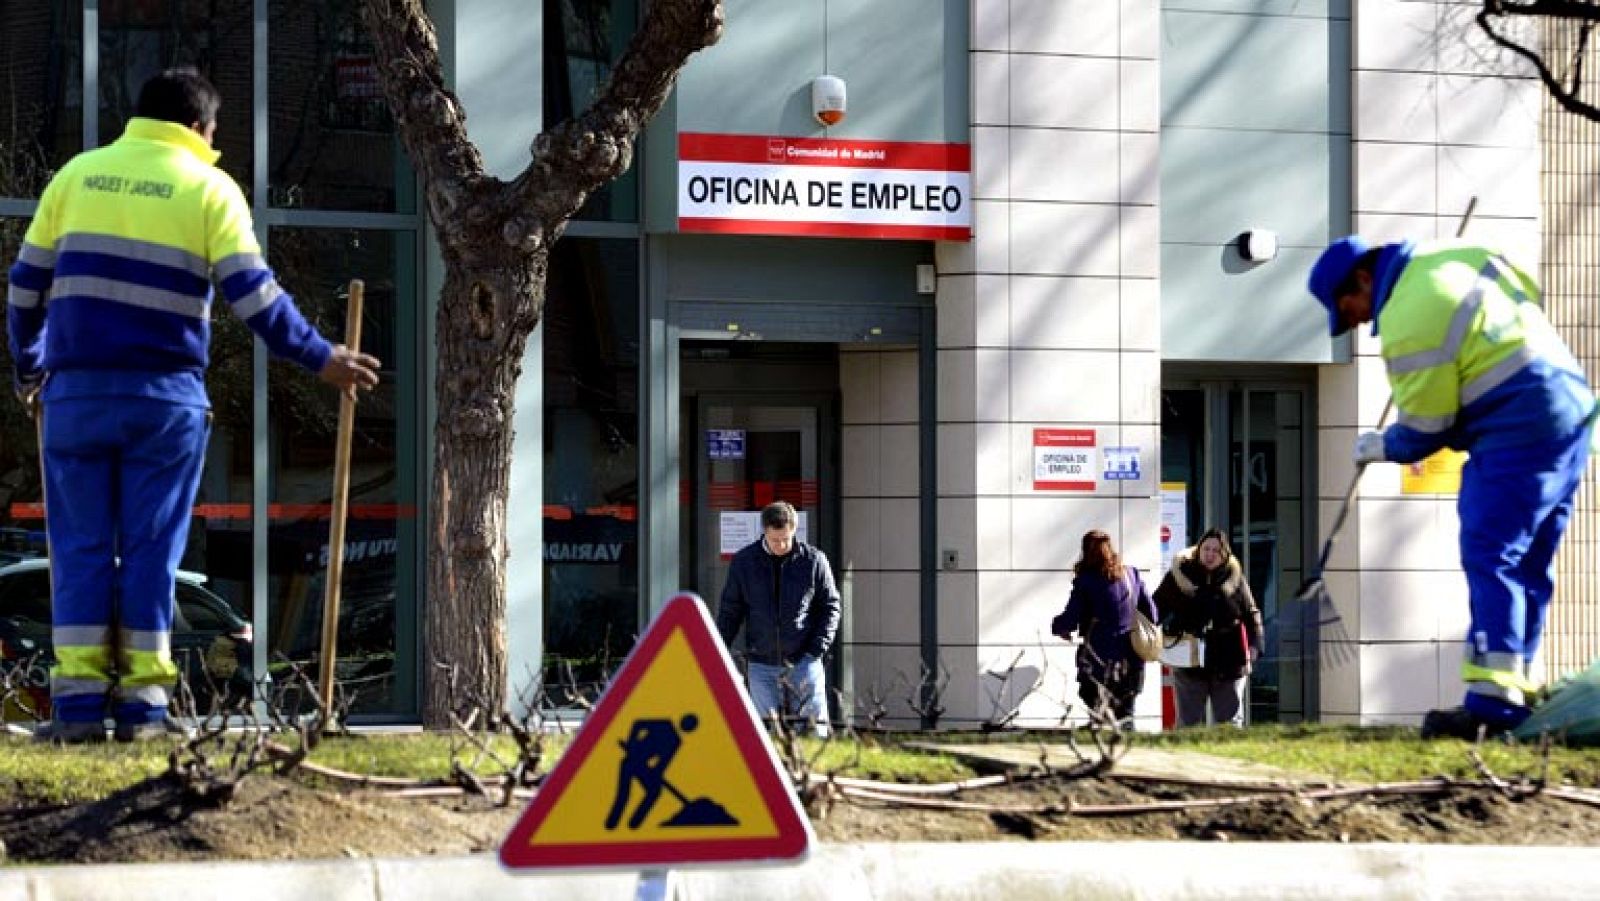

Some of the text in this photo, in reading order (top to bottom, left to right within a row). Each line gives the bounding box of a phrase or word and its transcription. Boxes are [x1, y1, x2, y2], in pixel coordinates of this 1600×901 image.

[787, 146, 838, 158] Comunidad
[854, 149, 886, 160] Madrid
[688, 175, 962, 213] OFICINA DE EMPLEO
[1043, 454, 1088, 464] OFICINA DE
[1048, 464, 1081, 474] EMPLEO
